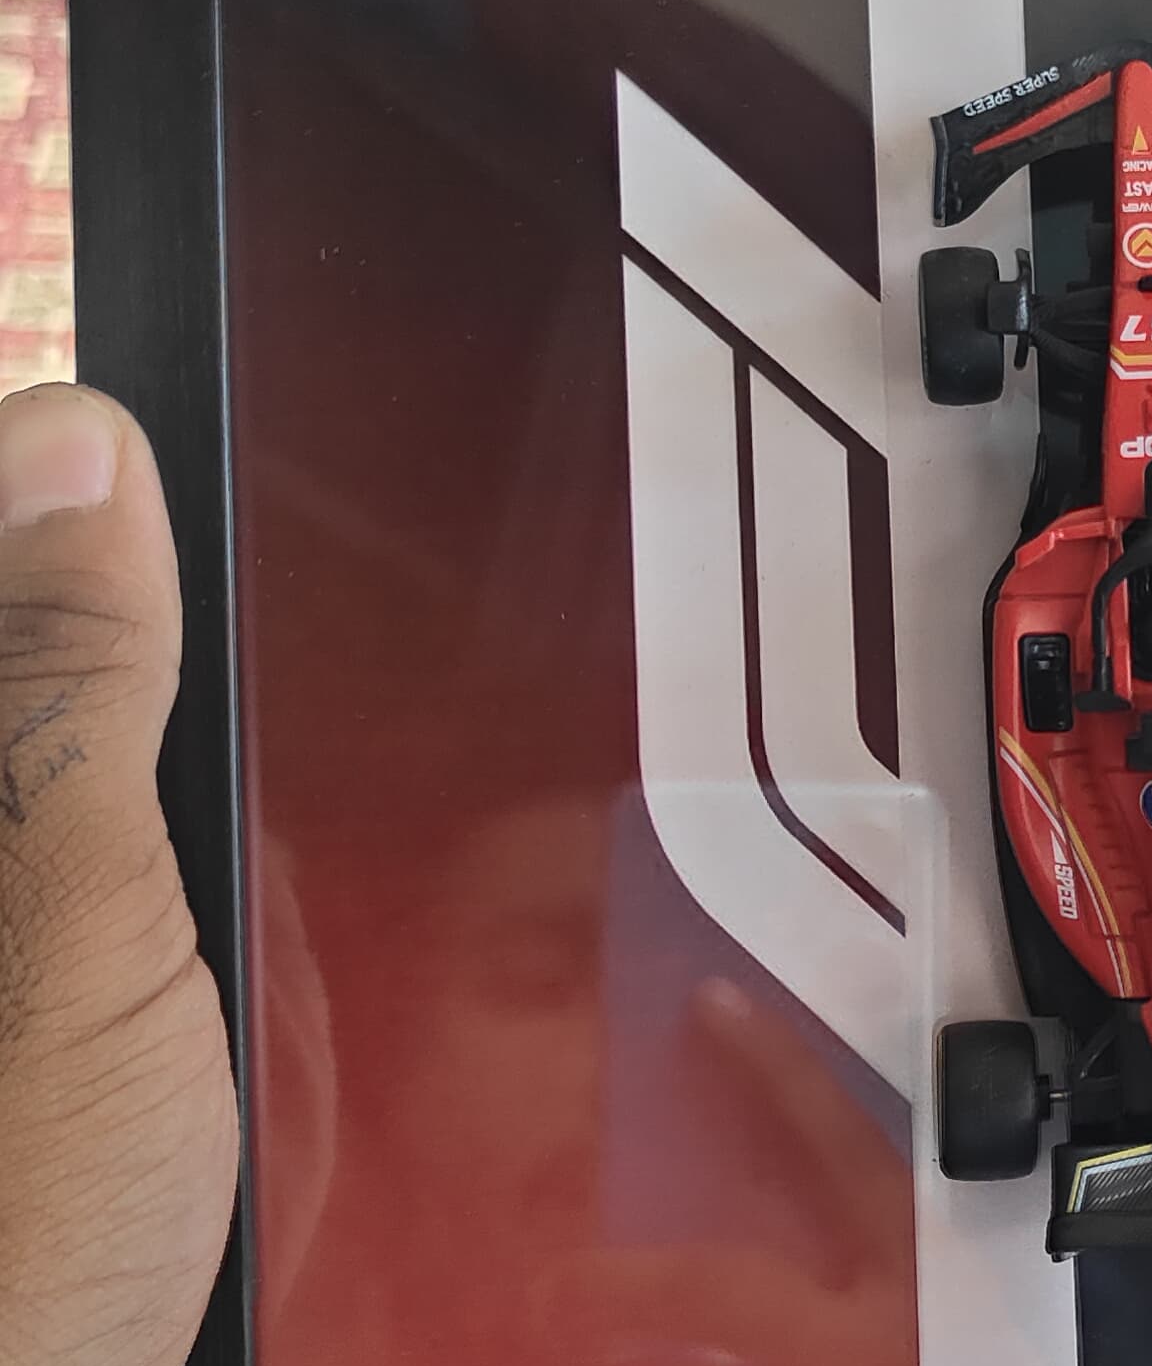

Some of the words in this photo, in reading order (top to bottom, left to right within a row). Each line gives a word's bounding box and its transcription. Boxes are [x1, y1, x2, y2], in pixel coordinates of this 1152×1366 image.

[1012, 67, 1060, 100] SUPER
[963, 89, 1013, 117] SPEED
[1054, 863, 1078, 920] SPEED
